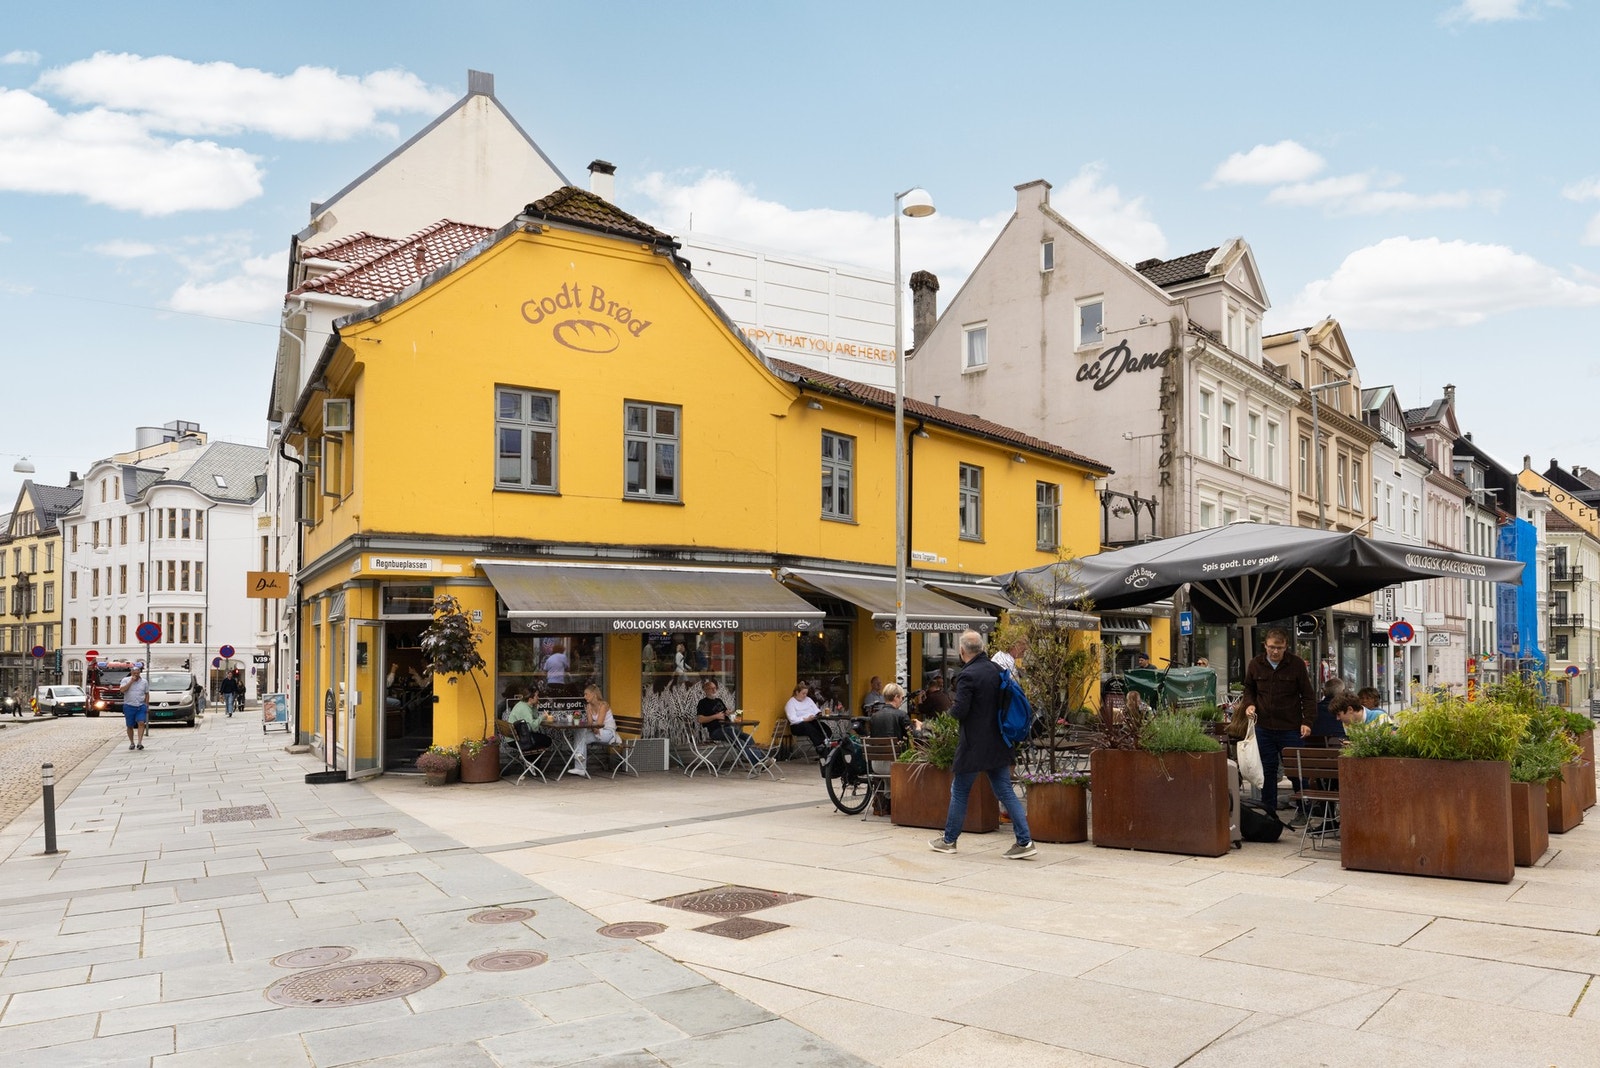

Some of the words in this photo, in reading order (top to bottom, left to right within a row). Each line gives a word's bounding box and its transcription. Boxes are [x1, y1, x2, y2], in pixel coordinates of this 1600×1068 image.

[521, 281, 582, 325] Godt
[588, 285, 652, 338] Brød
[775, 332, 807, 348] THAT
[808, 338, 834, 352] YOU
[835, 343, 857, 357] ARE
[858, 346, 888, 362] HERE
[1158, 376, 1172, 487] FRISØR
[1541, 487, 1597, 522] HOTEL
[375, 558, 428, 570] Regnbueplassen
[1202, 563, 1219, 572] Spis
[1220, 560, 1241, 571] godt.
[1242, 558, 1257, 566] Lev
[1258, 555, 1280, 566] godt.
[1405, 552, 1441, 571] ØKOLOGISK
[1441, 559, 1486, 577] BAKEVERKSTED
[1124, 567, 1140, 585] Godt
[612, 619, 668, 630] ØKOLOGISK
[669, 620, 739, 629] BAKEVERKSTED
[934, 622, 970, 631] BAKEVERKSTED
[566, 701, 584, 709] godt.
